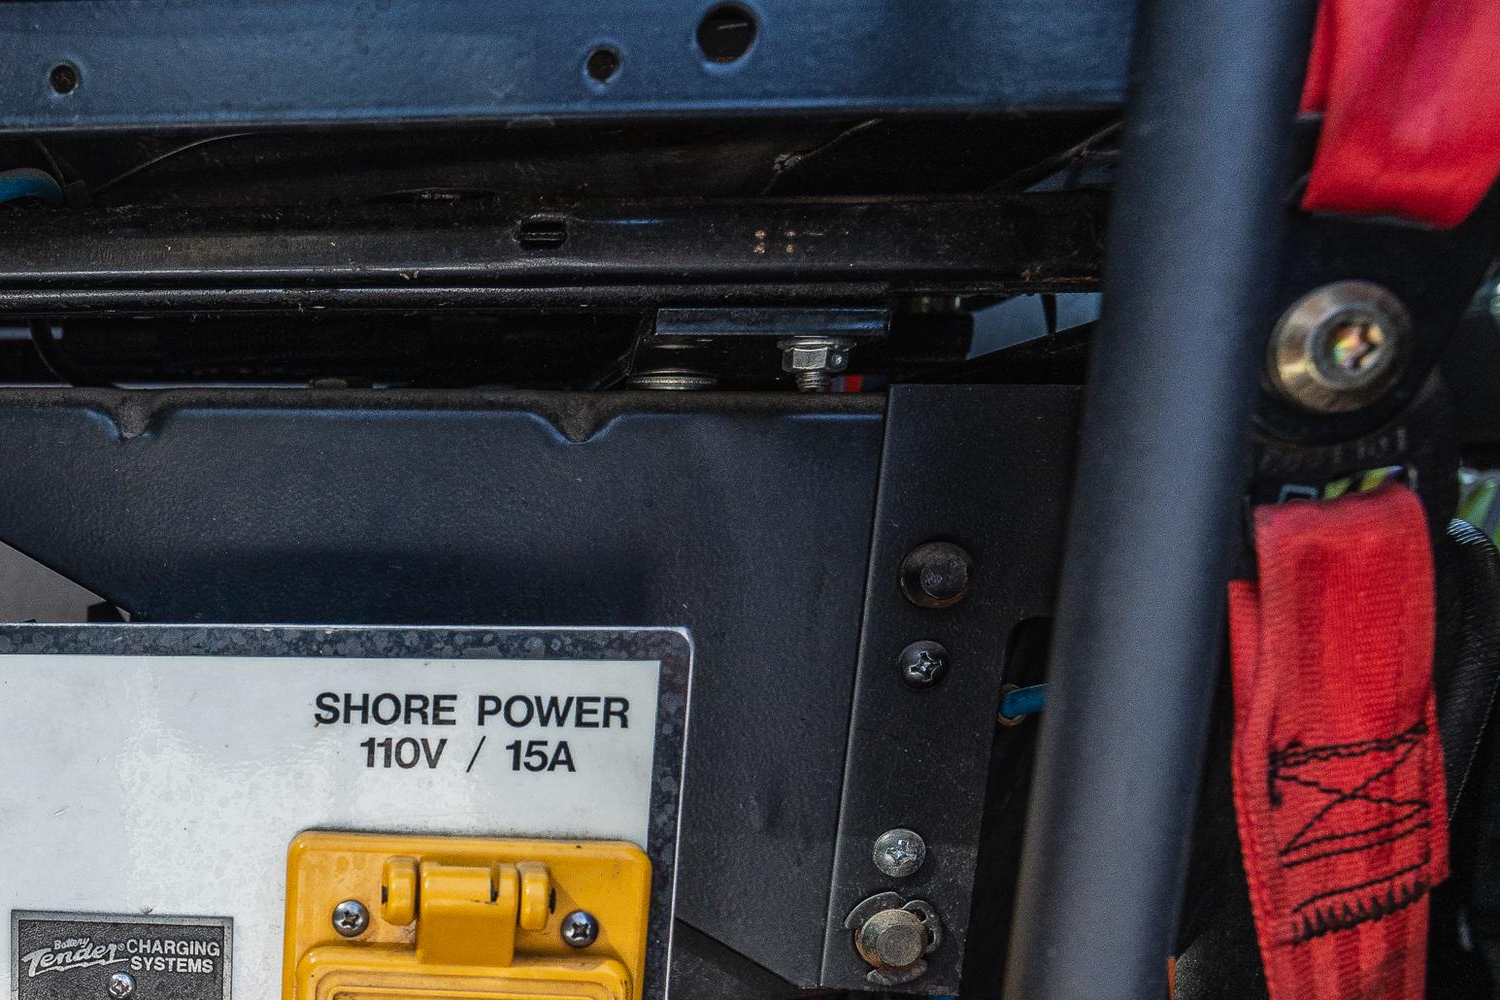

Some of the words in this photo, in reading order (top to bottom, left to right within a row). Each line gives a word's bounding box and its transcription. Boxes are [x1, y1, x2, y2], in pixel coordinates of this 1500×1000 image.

[314, 692, 458, 726] SHORE
[477, 694, 630, 729] POWER
[360, 737, 448, 770] 110V
[466, 735, 487, 773] /
[505, 739, 577, 773] 15A
[54, 936, 91, 951] Battery
[126, 938, 221, 957] CHARGING
[130, 956, 214, 974] SYSTEMS
